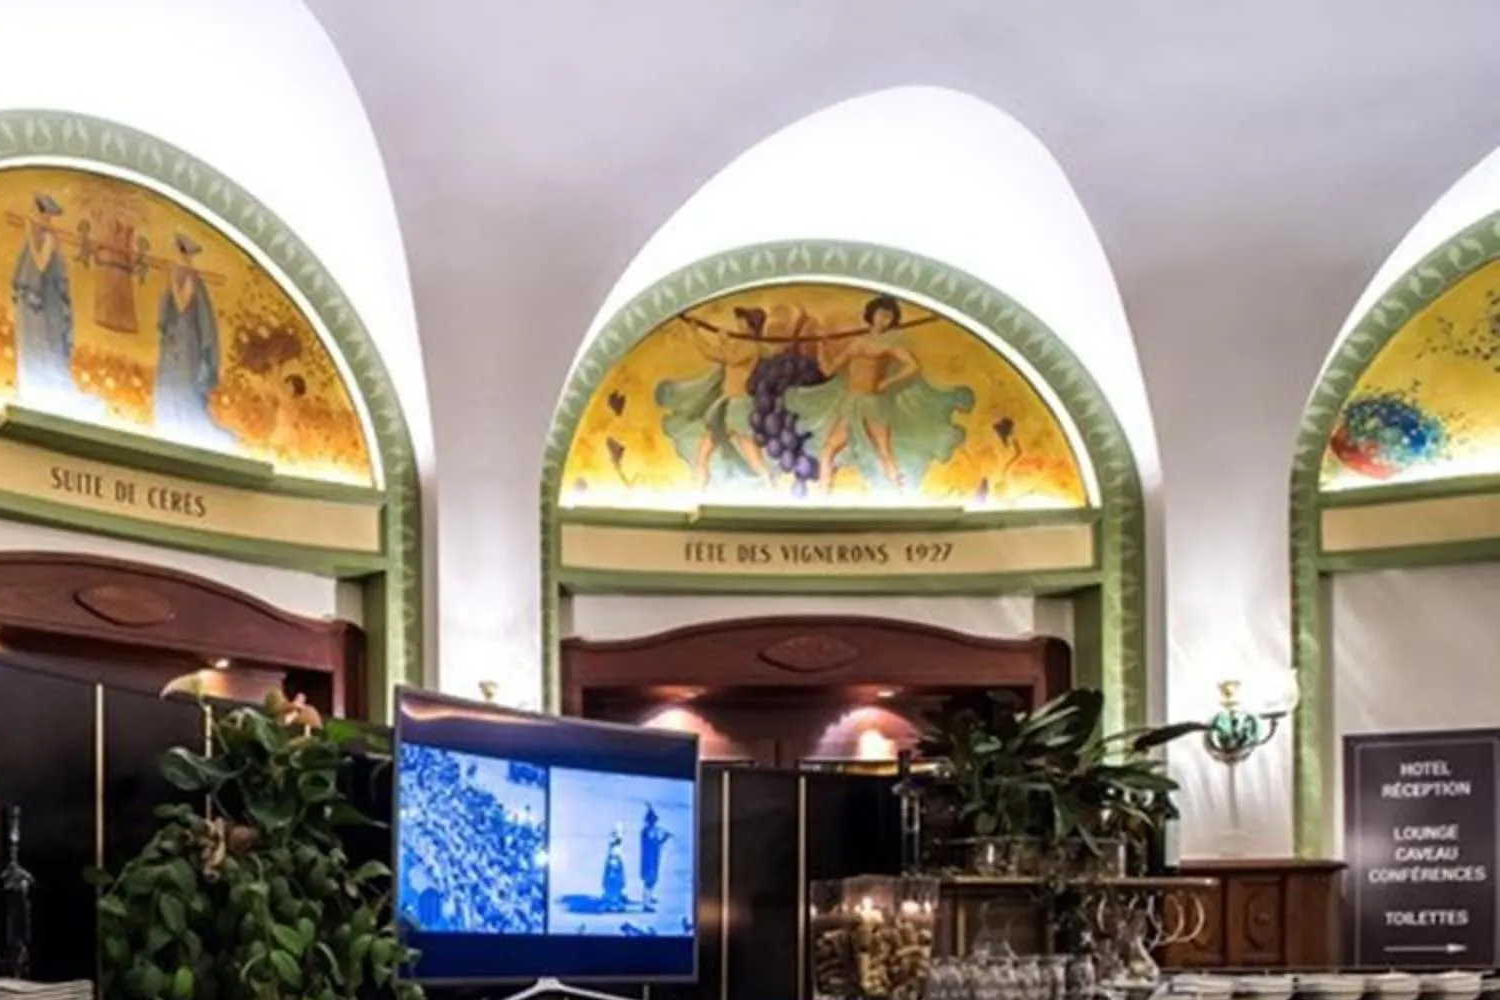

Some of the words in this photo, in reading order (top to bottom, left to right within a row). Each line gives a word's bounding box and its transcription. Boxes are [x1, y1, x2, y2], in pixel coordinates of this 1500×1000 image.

[50, 466, 103, 498] SUITE
[114, 480, 136, 505] DE
[736, 542, 772, 564] DES
[780, 543, 891, 564] VIGNERONS
[904, 542, 954, 562] 1927
[1392, 823, 1459, 841] LOUNGE
[1394, 846, 1460, 861] CAVEAU
[1384, 908, 1470, 926] TOILETTES
